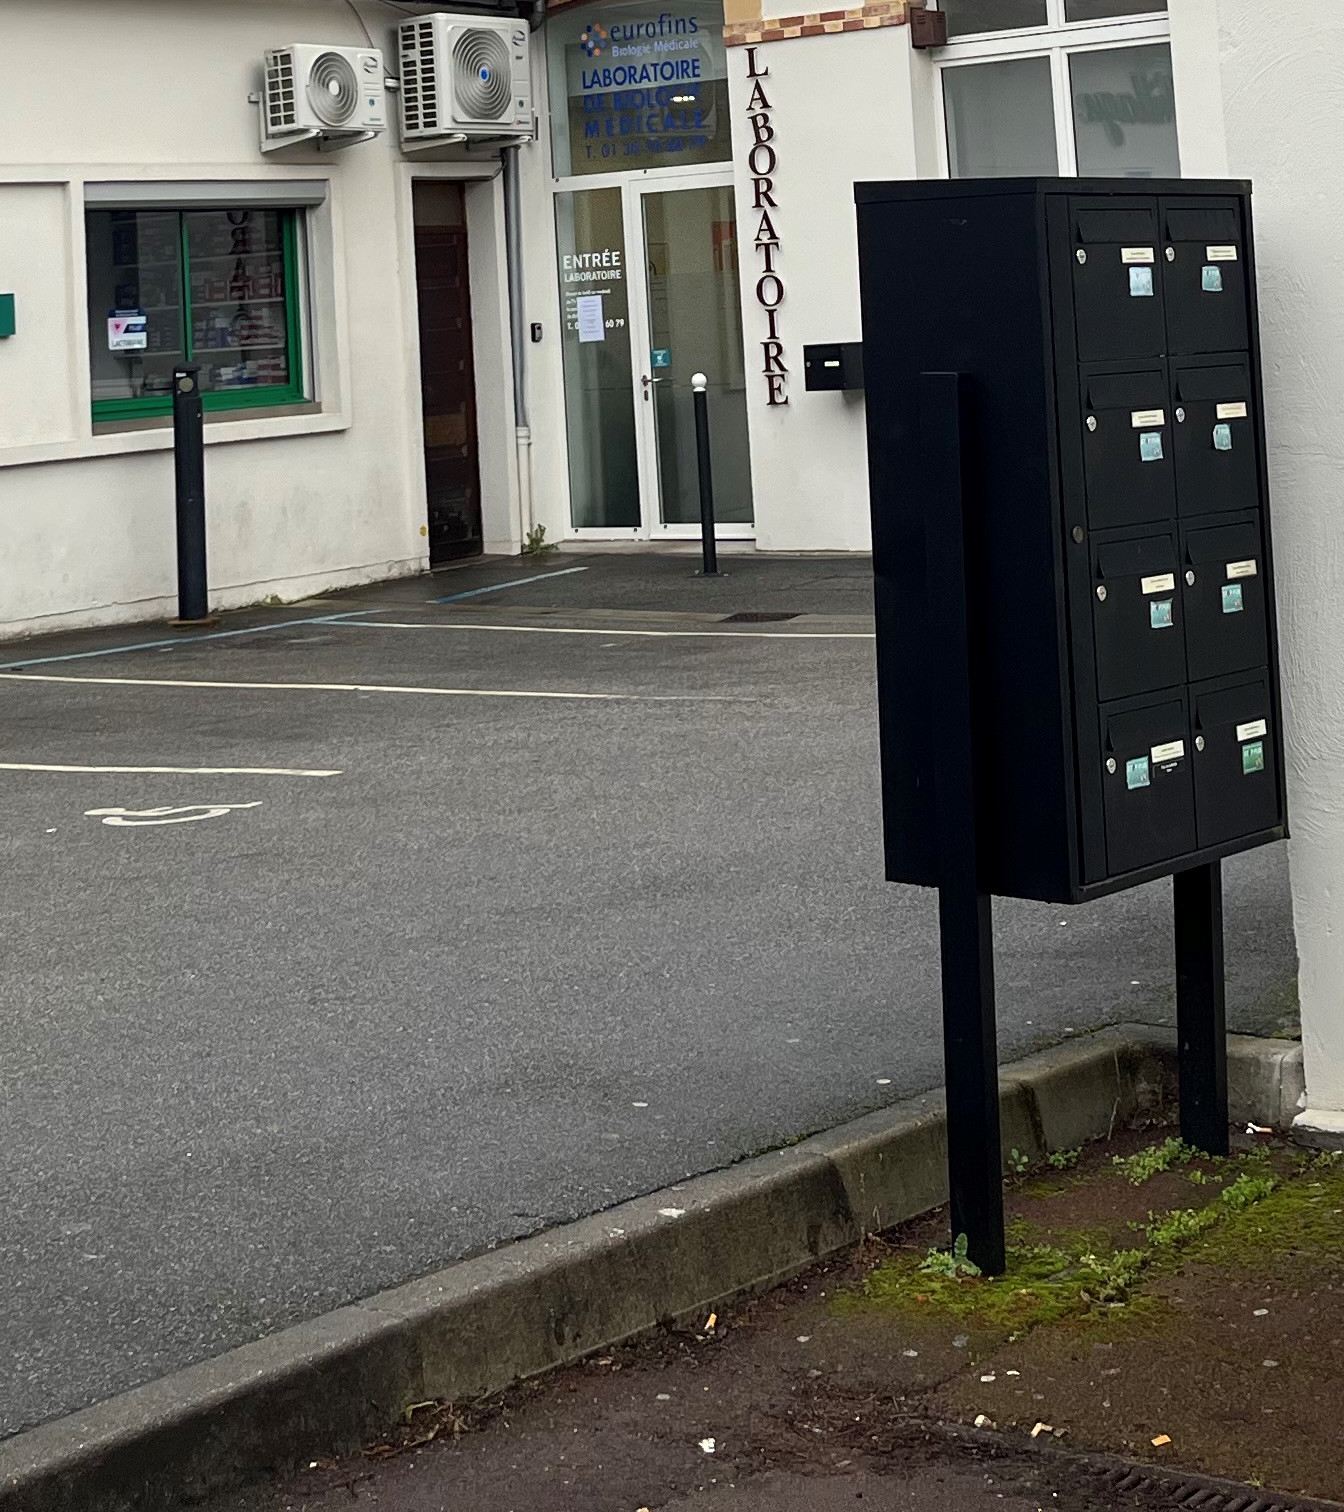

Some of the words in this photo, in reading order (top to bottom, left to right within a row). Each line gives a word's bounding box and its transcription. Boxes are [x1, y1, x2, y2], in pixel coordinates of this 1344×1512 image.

[610, 13, 698, 42] eurofins
[582, 58, 701, 90] LABORATOIRE
[745, 46, 789, 406] LABORATOIRE
[562, 248, 622, 270] ENTRÉE
[564, 269, 623, 283] LABORATOIRE
